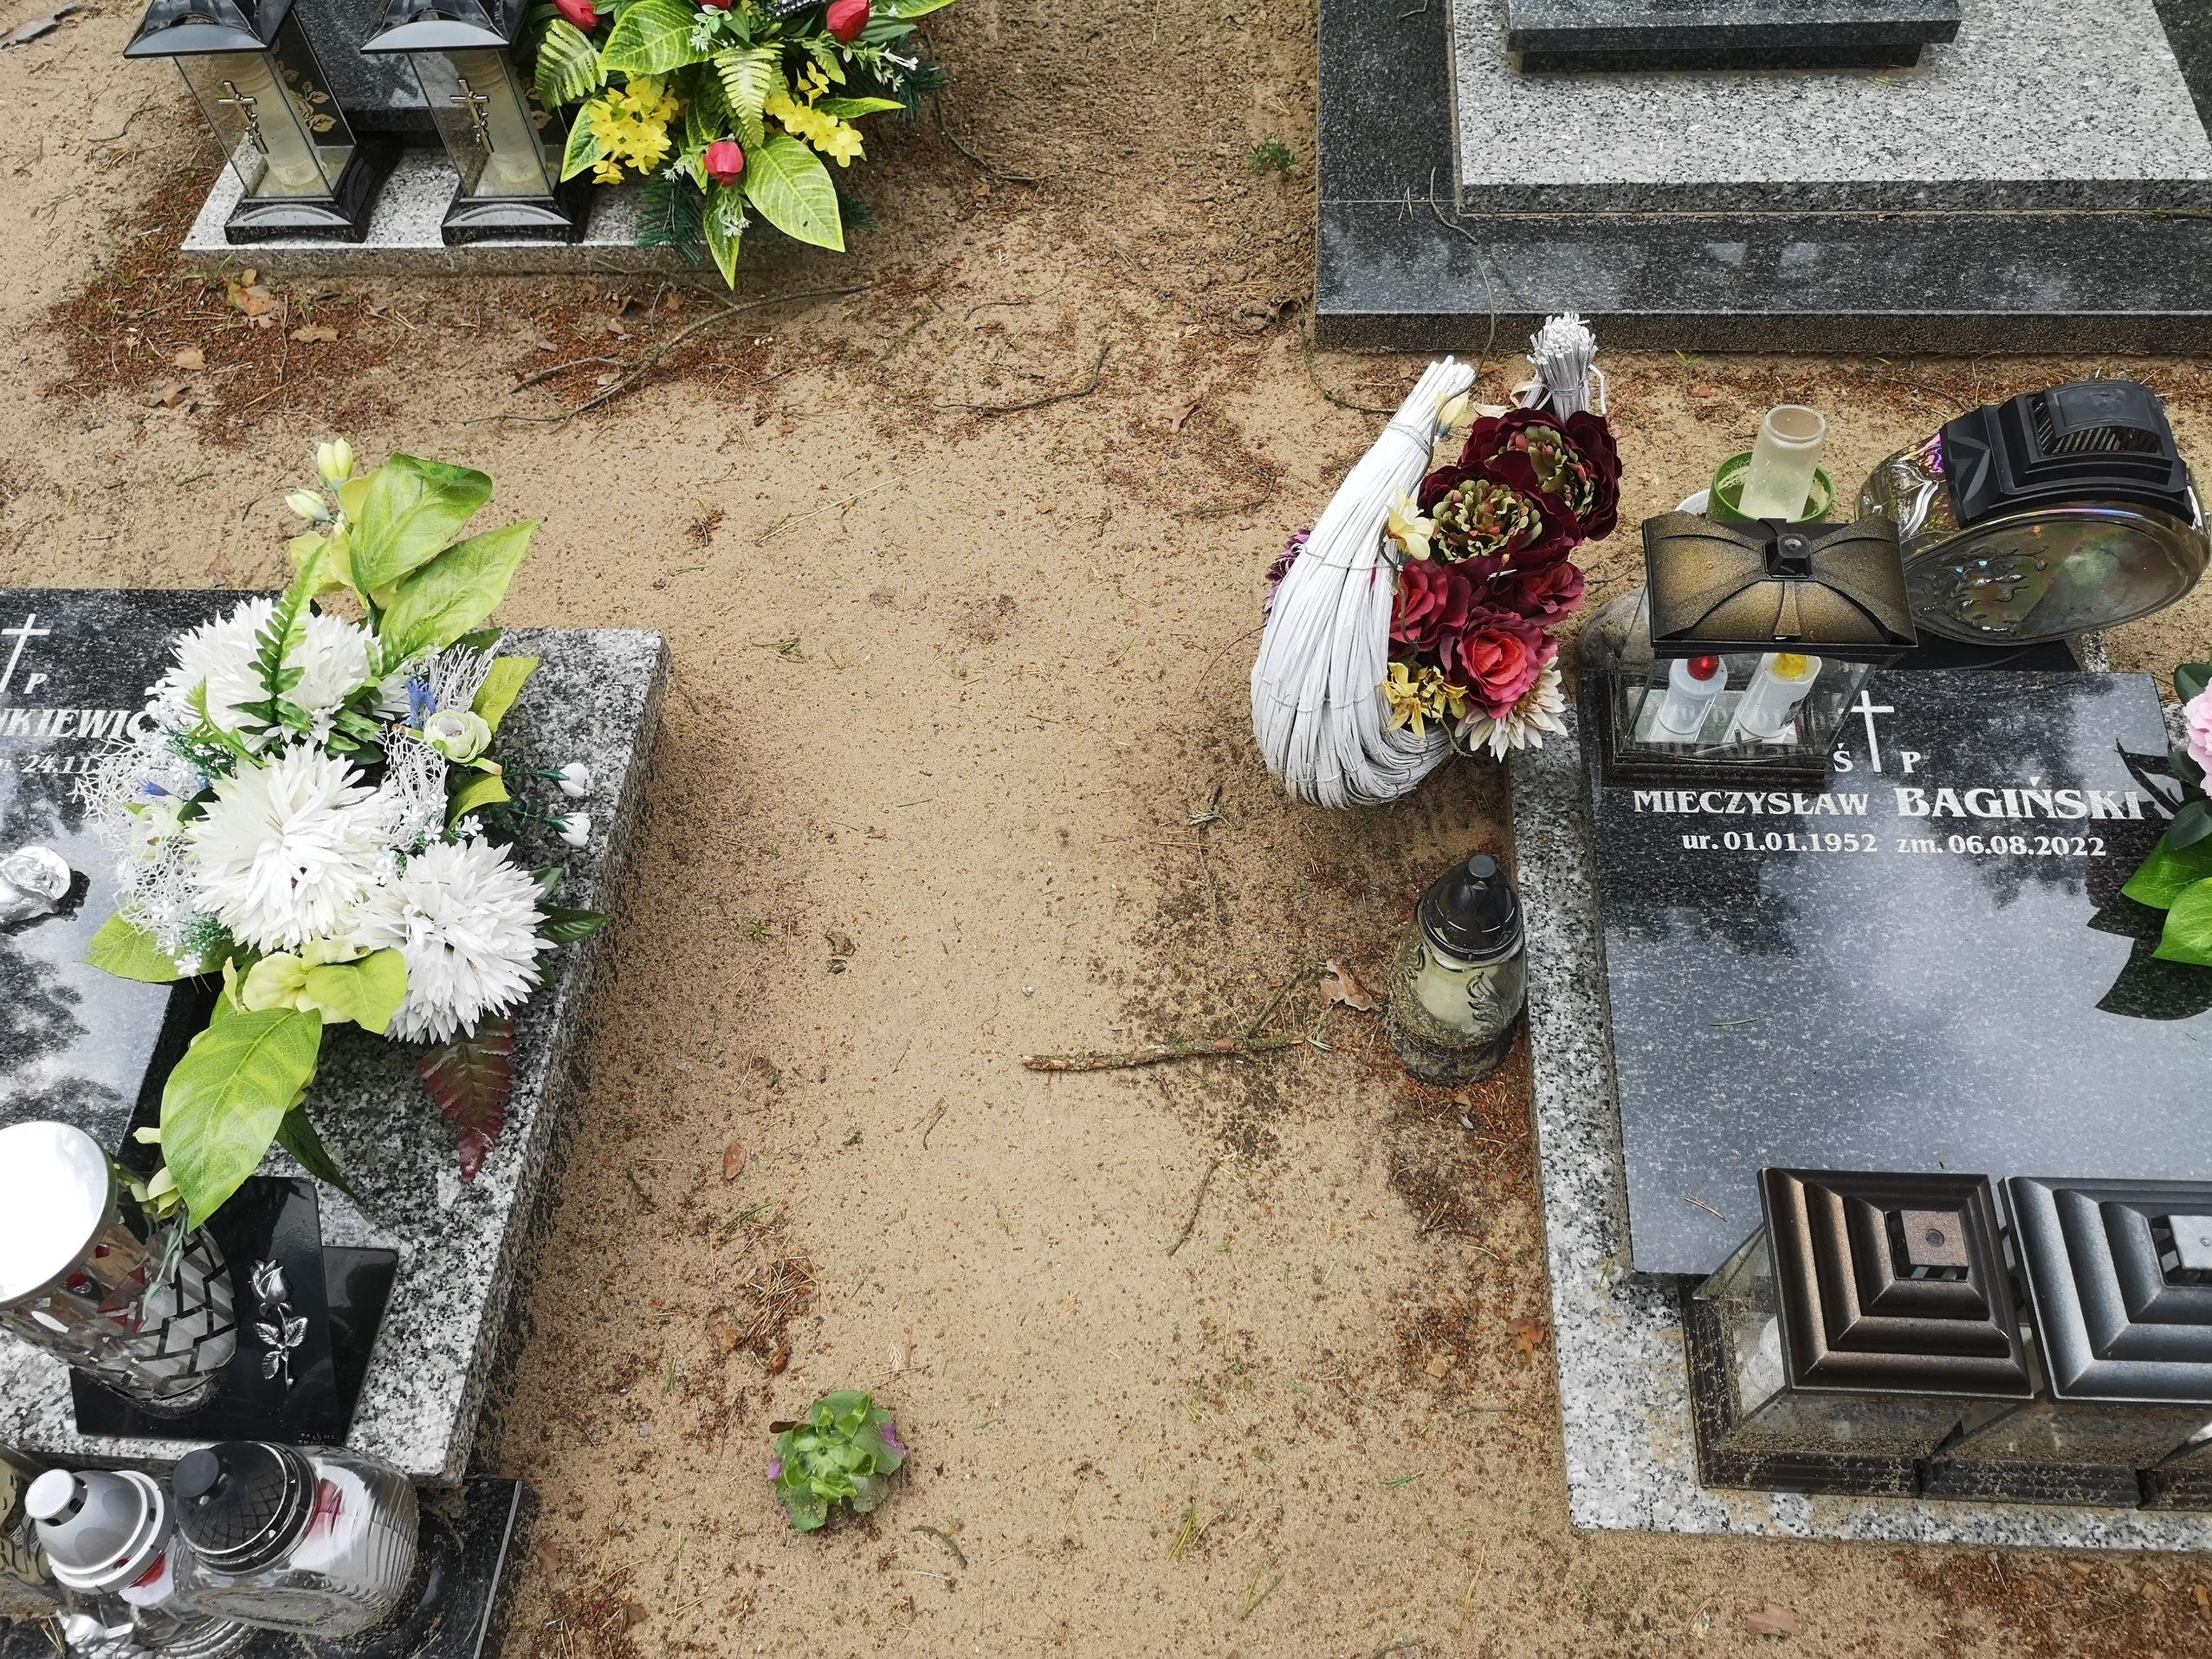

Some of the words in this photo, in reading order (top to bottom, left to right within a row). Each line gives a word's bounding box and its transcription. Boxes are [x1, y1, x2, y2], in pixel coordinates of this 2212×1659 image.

[23, 673, 48, 694] P
[1833, 742, 1853, 773] Ś
[1900, 751, 1922, 774] P
[1632, 790, 1869, 816] MIECZYSŁAW
[1892, 776, 2145, 820] BAGIŃSKI
[1681, 834, 1719, 850] ur.
[1723, 831, 1878, 852] 01.01.1952
[1896, 839, 1944, 854] zm.
[1948, 835, 2106, 857] 06.08.2022
